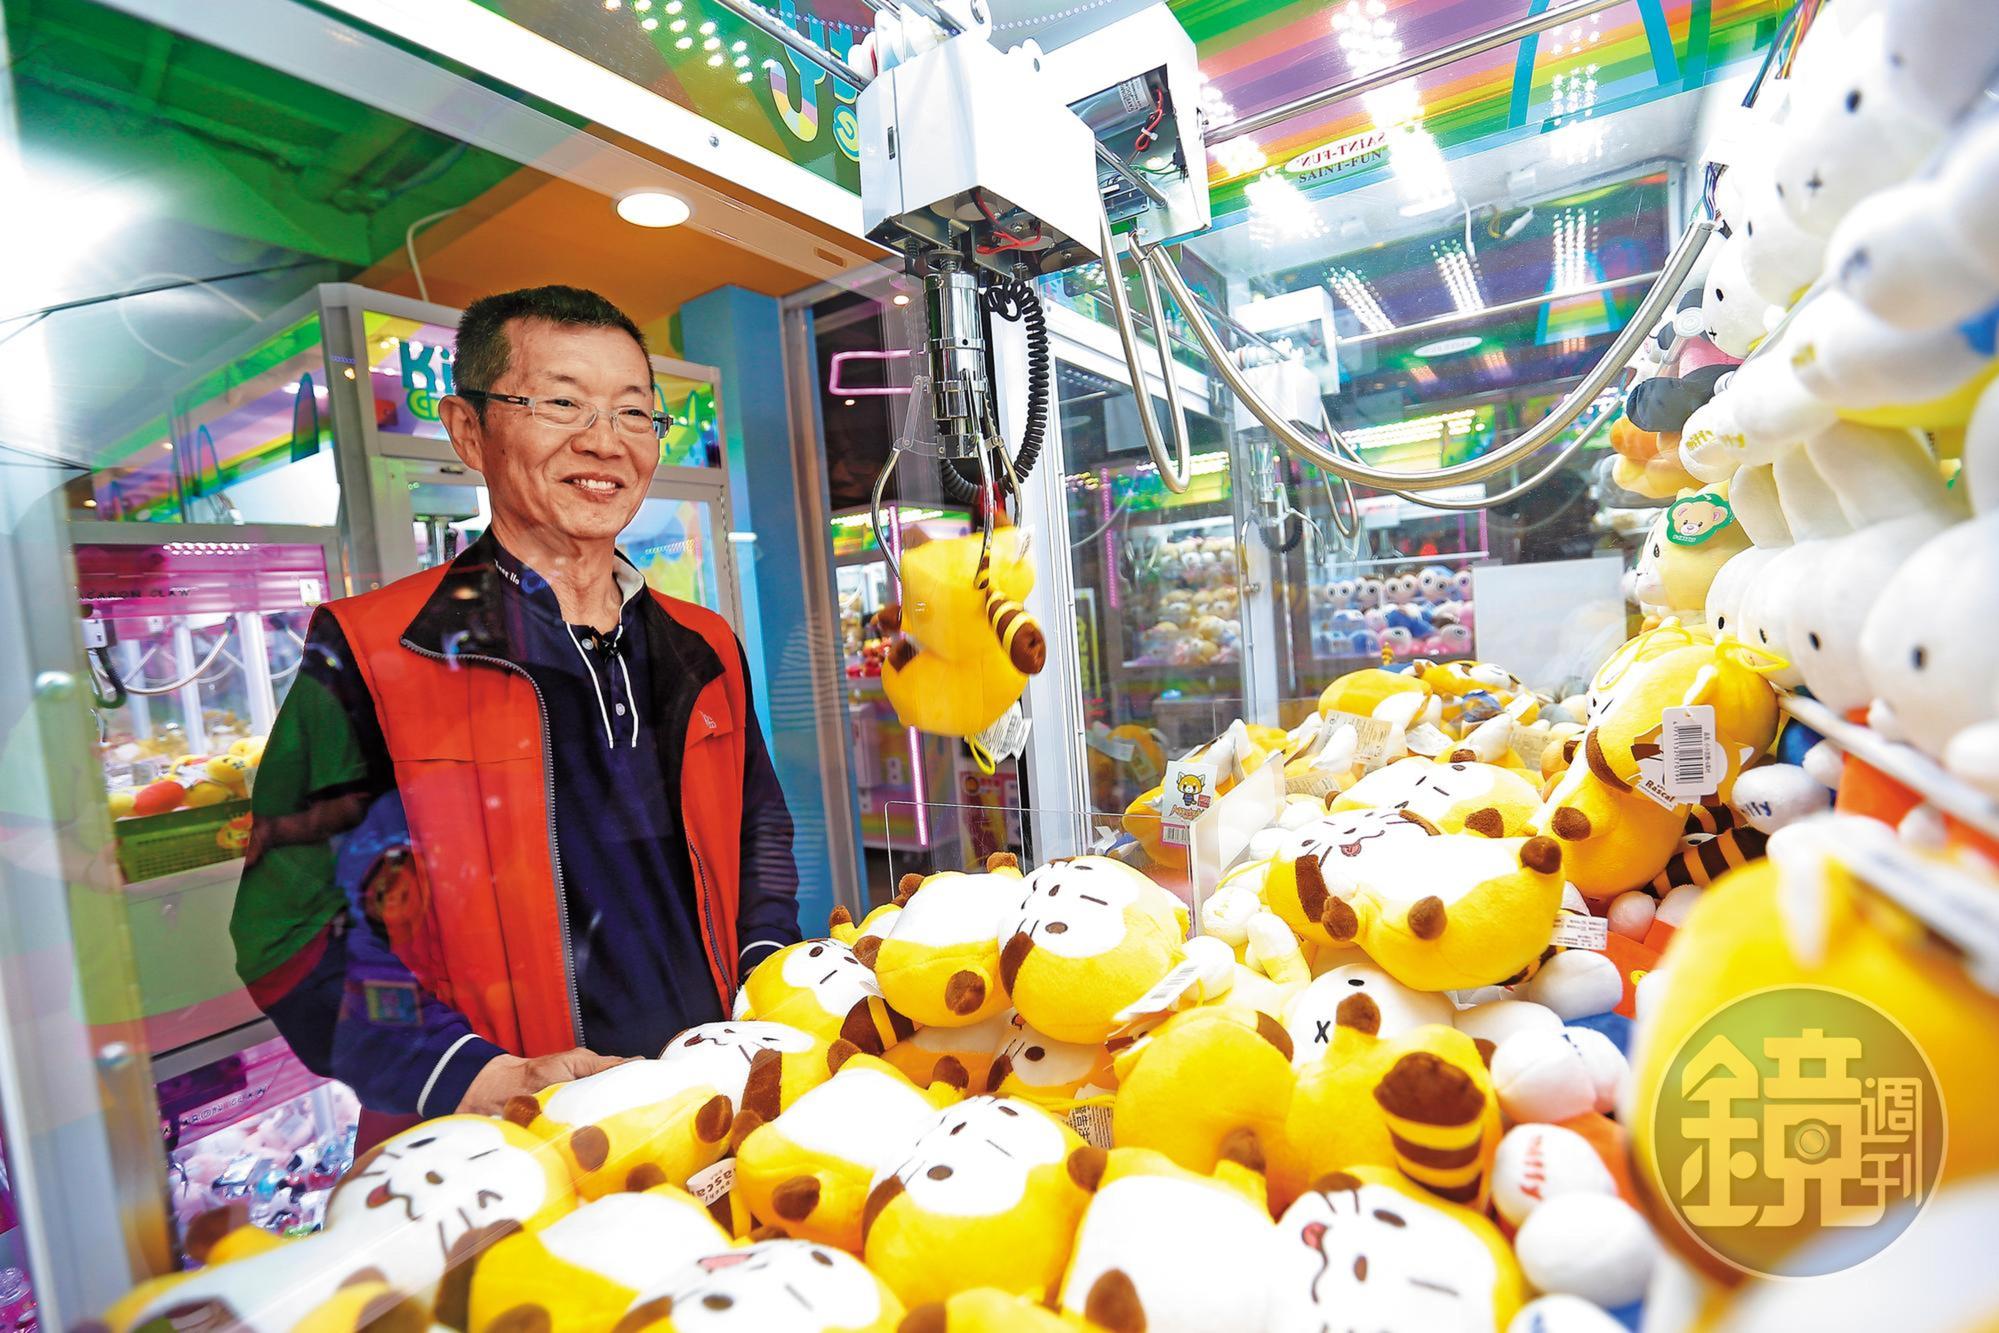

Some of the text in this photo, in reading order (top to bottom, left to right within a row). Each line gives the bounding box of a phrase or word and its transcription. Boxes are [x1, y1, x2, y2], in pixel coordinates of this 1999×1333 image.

[1298, 151, 1382, 183] SAINT-FUN
[1645, 780, 1675, 802] Rascal
[695, 1168, 735, 1197] asca
